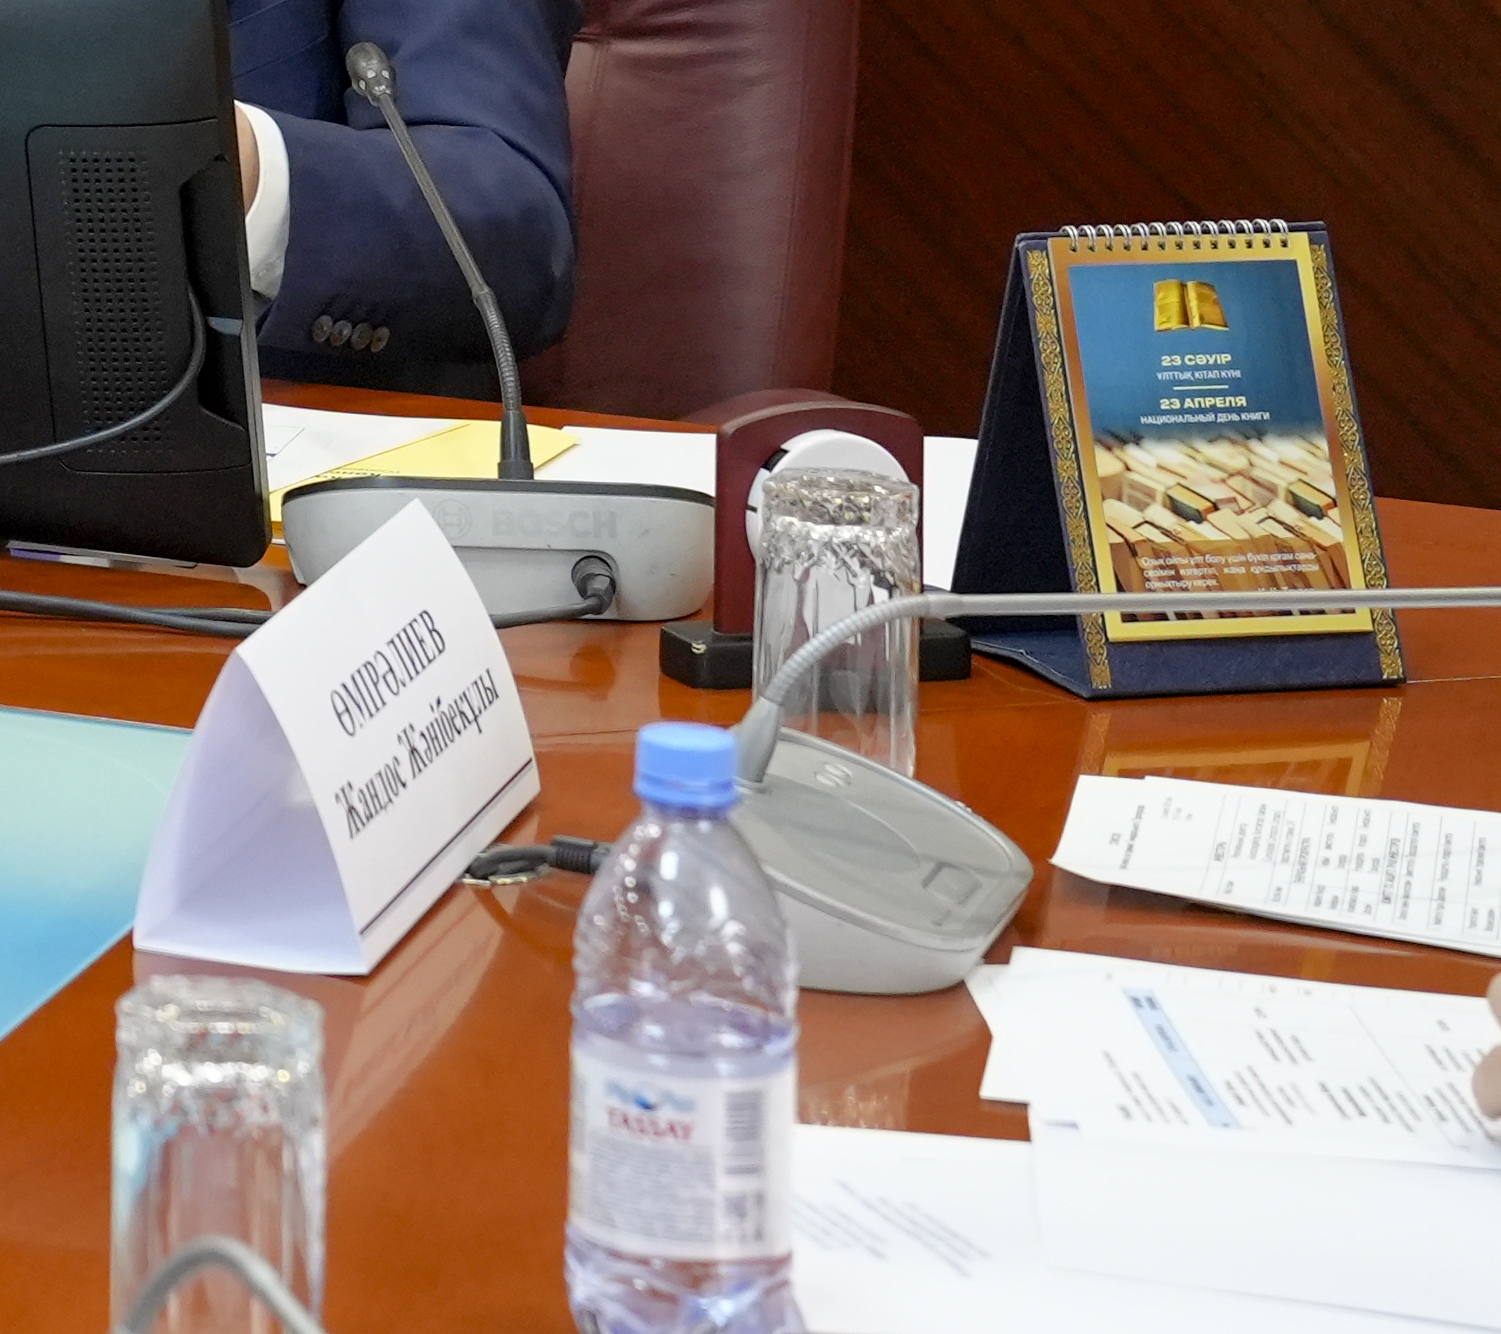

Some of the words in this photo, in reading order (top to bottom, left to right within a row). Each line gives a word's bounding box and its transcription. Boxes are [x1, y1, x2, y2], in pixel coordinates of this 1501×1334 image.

[1161, 355, 1182, 367] 23
[1184, 353, 1232, 366] СӘУІР
[1160, 398, 1181, 410] 23
[1183, 396, 1247, 409] АПРЕЛЯ
[1140, 412, 1216, 425] НАЦИОНАЛЬНЫЙ
[1216, 412, 1240, 423] ДЕНЬ
[1241, 411, 1271, 422] КНИГИ
[491, 509, 618, 539] BOSCH
[330, 609, 446, 738] ӨМІРӘЛИЕВ
[334, 755, 408, 841] Жандос
